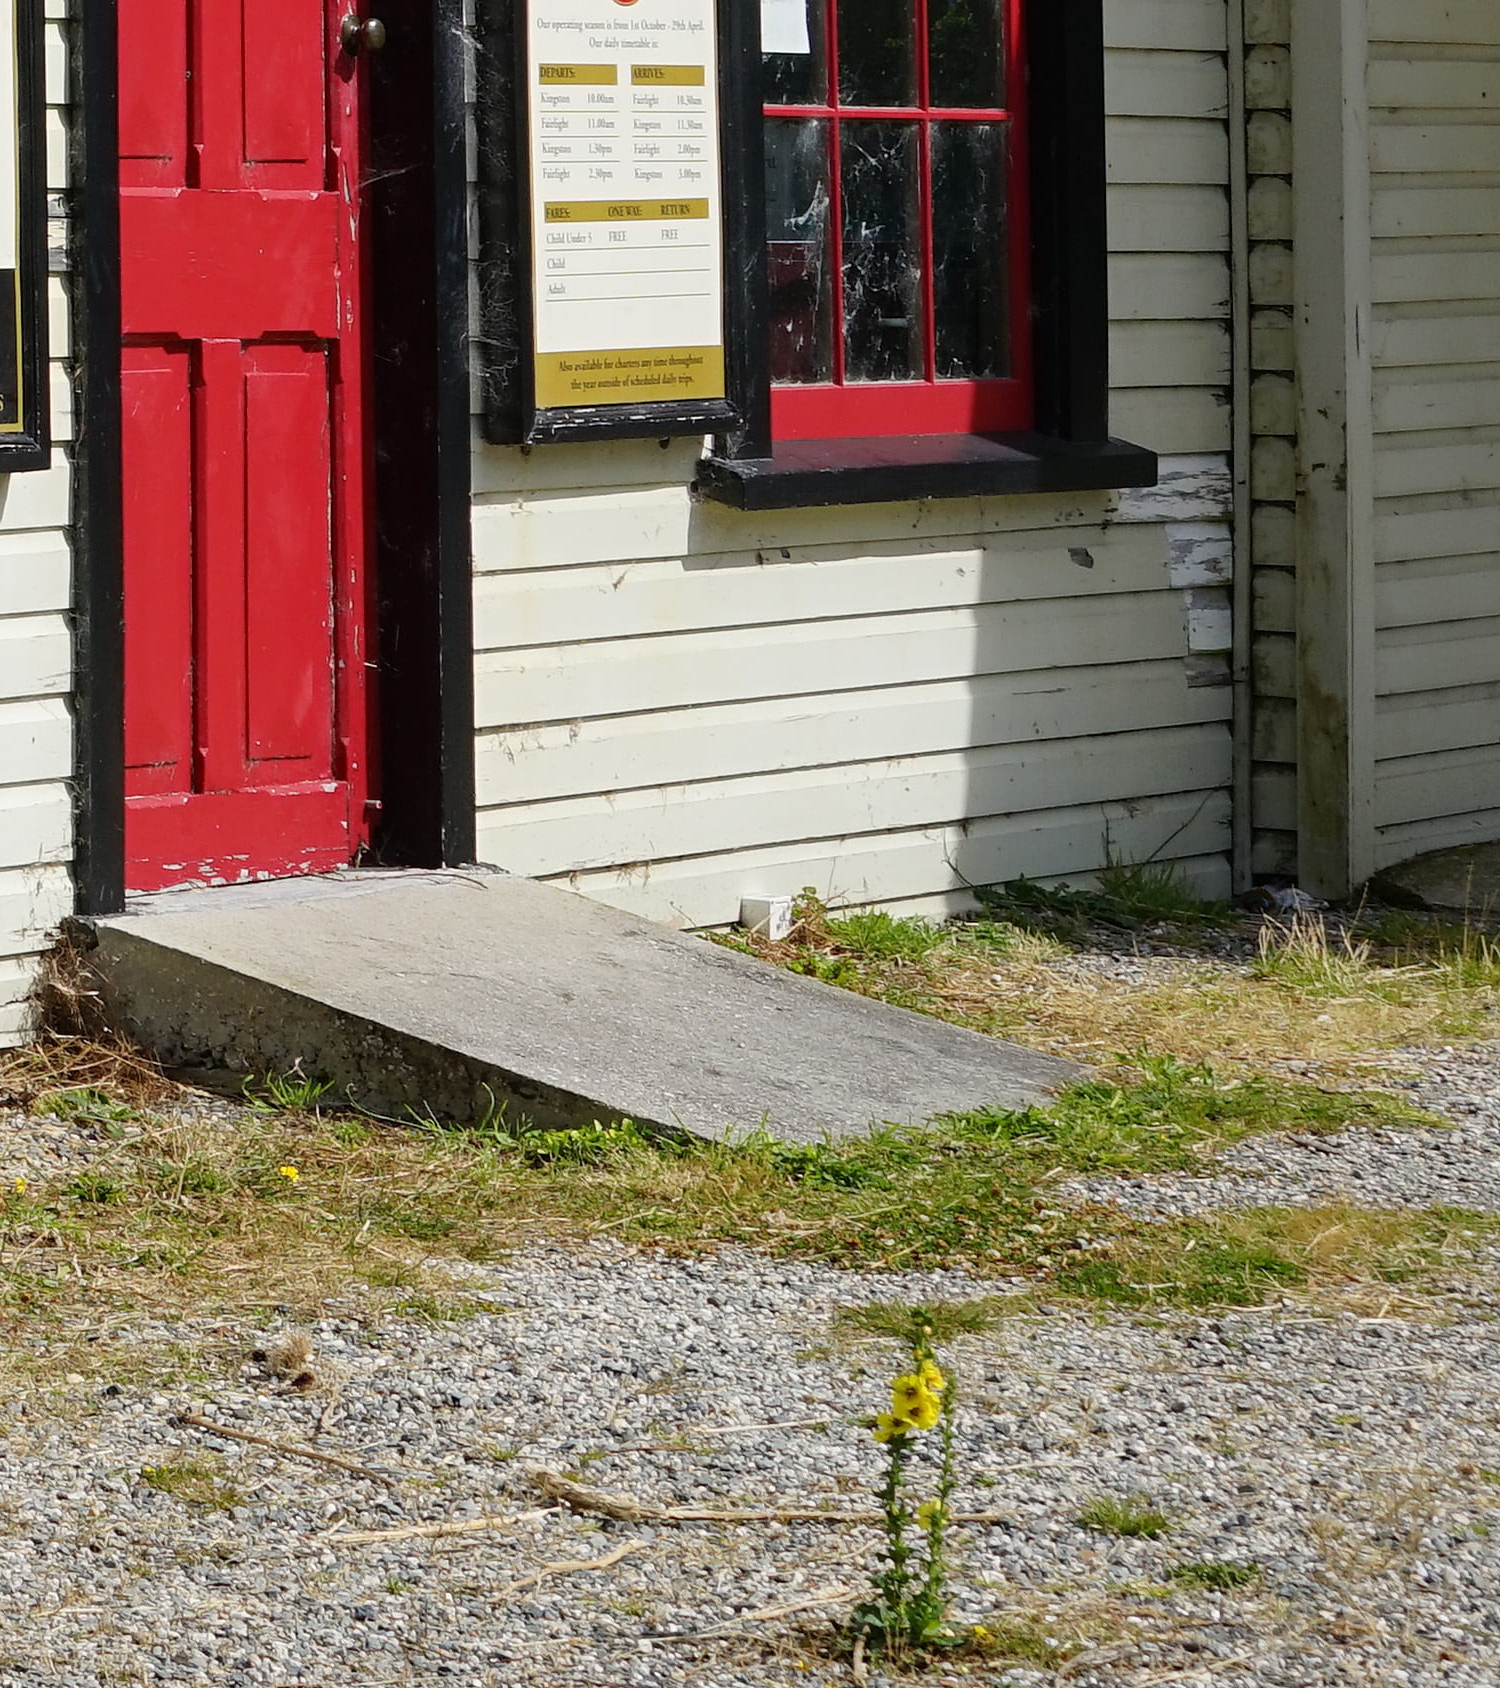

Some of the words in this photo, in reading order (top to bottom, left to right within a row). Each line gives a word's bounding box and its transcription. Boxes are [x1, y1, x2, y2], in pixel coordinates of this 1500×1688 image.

[552, 20, 583, 33] operating
[613, 19, 629, 30] from
[640, 18, 666, 30] October
[604, 36, 619, 51] daily
[546, 232, 565, 244] Child
[566, 232, 586, 244] Under
[609, 231, 627, 242] FREE
[661, 229, 678, 240] FREE
[547, 257, 566, 269] Child
